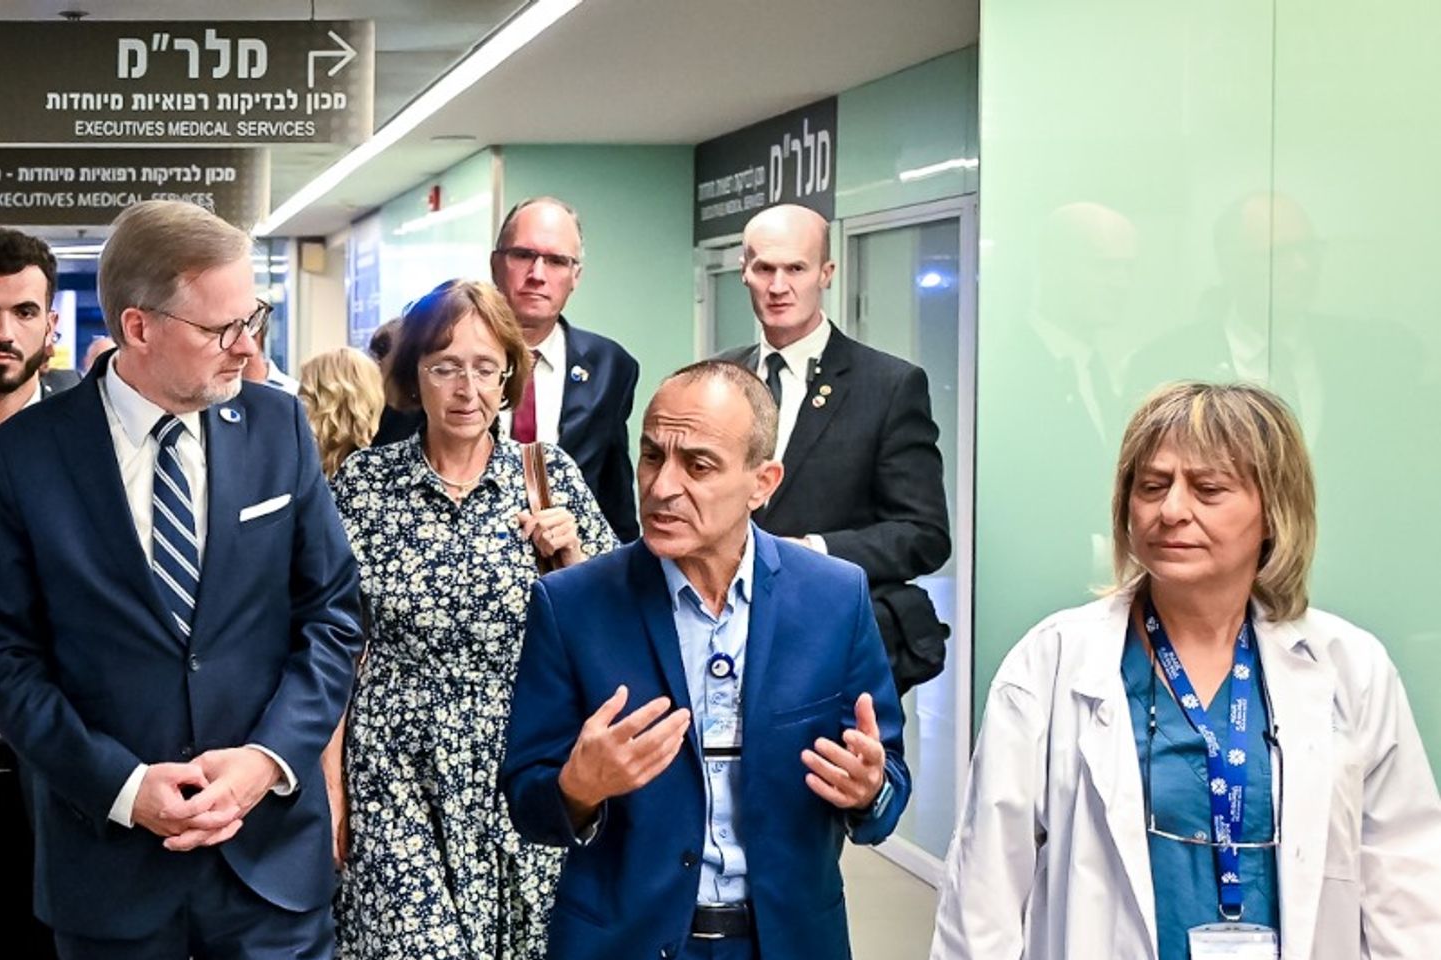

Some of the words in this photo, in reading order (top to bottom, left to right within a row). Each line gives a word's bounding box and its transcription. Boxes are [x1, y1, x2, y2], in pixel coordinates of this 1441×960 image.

[45, 92, 124, 111] מיוחדות
[131, 92, 209, 111] רפואיות
[216, 88, 298, 115] לבדיקות
[306, 92, 347, 115] מכון
[75, 120, 165, 137] EXECUTIVES
[168, 120, 231, 137] MEDICAL
[236, 120, 316, 137] SERVICES
[17, 167, 75, 182] מיוחדות
[79, 167, 137, 182] רפואיות
[140, 164, 202, 186] לבדיקות
[205, 167, 237, 186] מכון
[77, 192, 142, 207] MEDICAL
